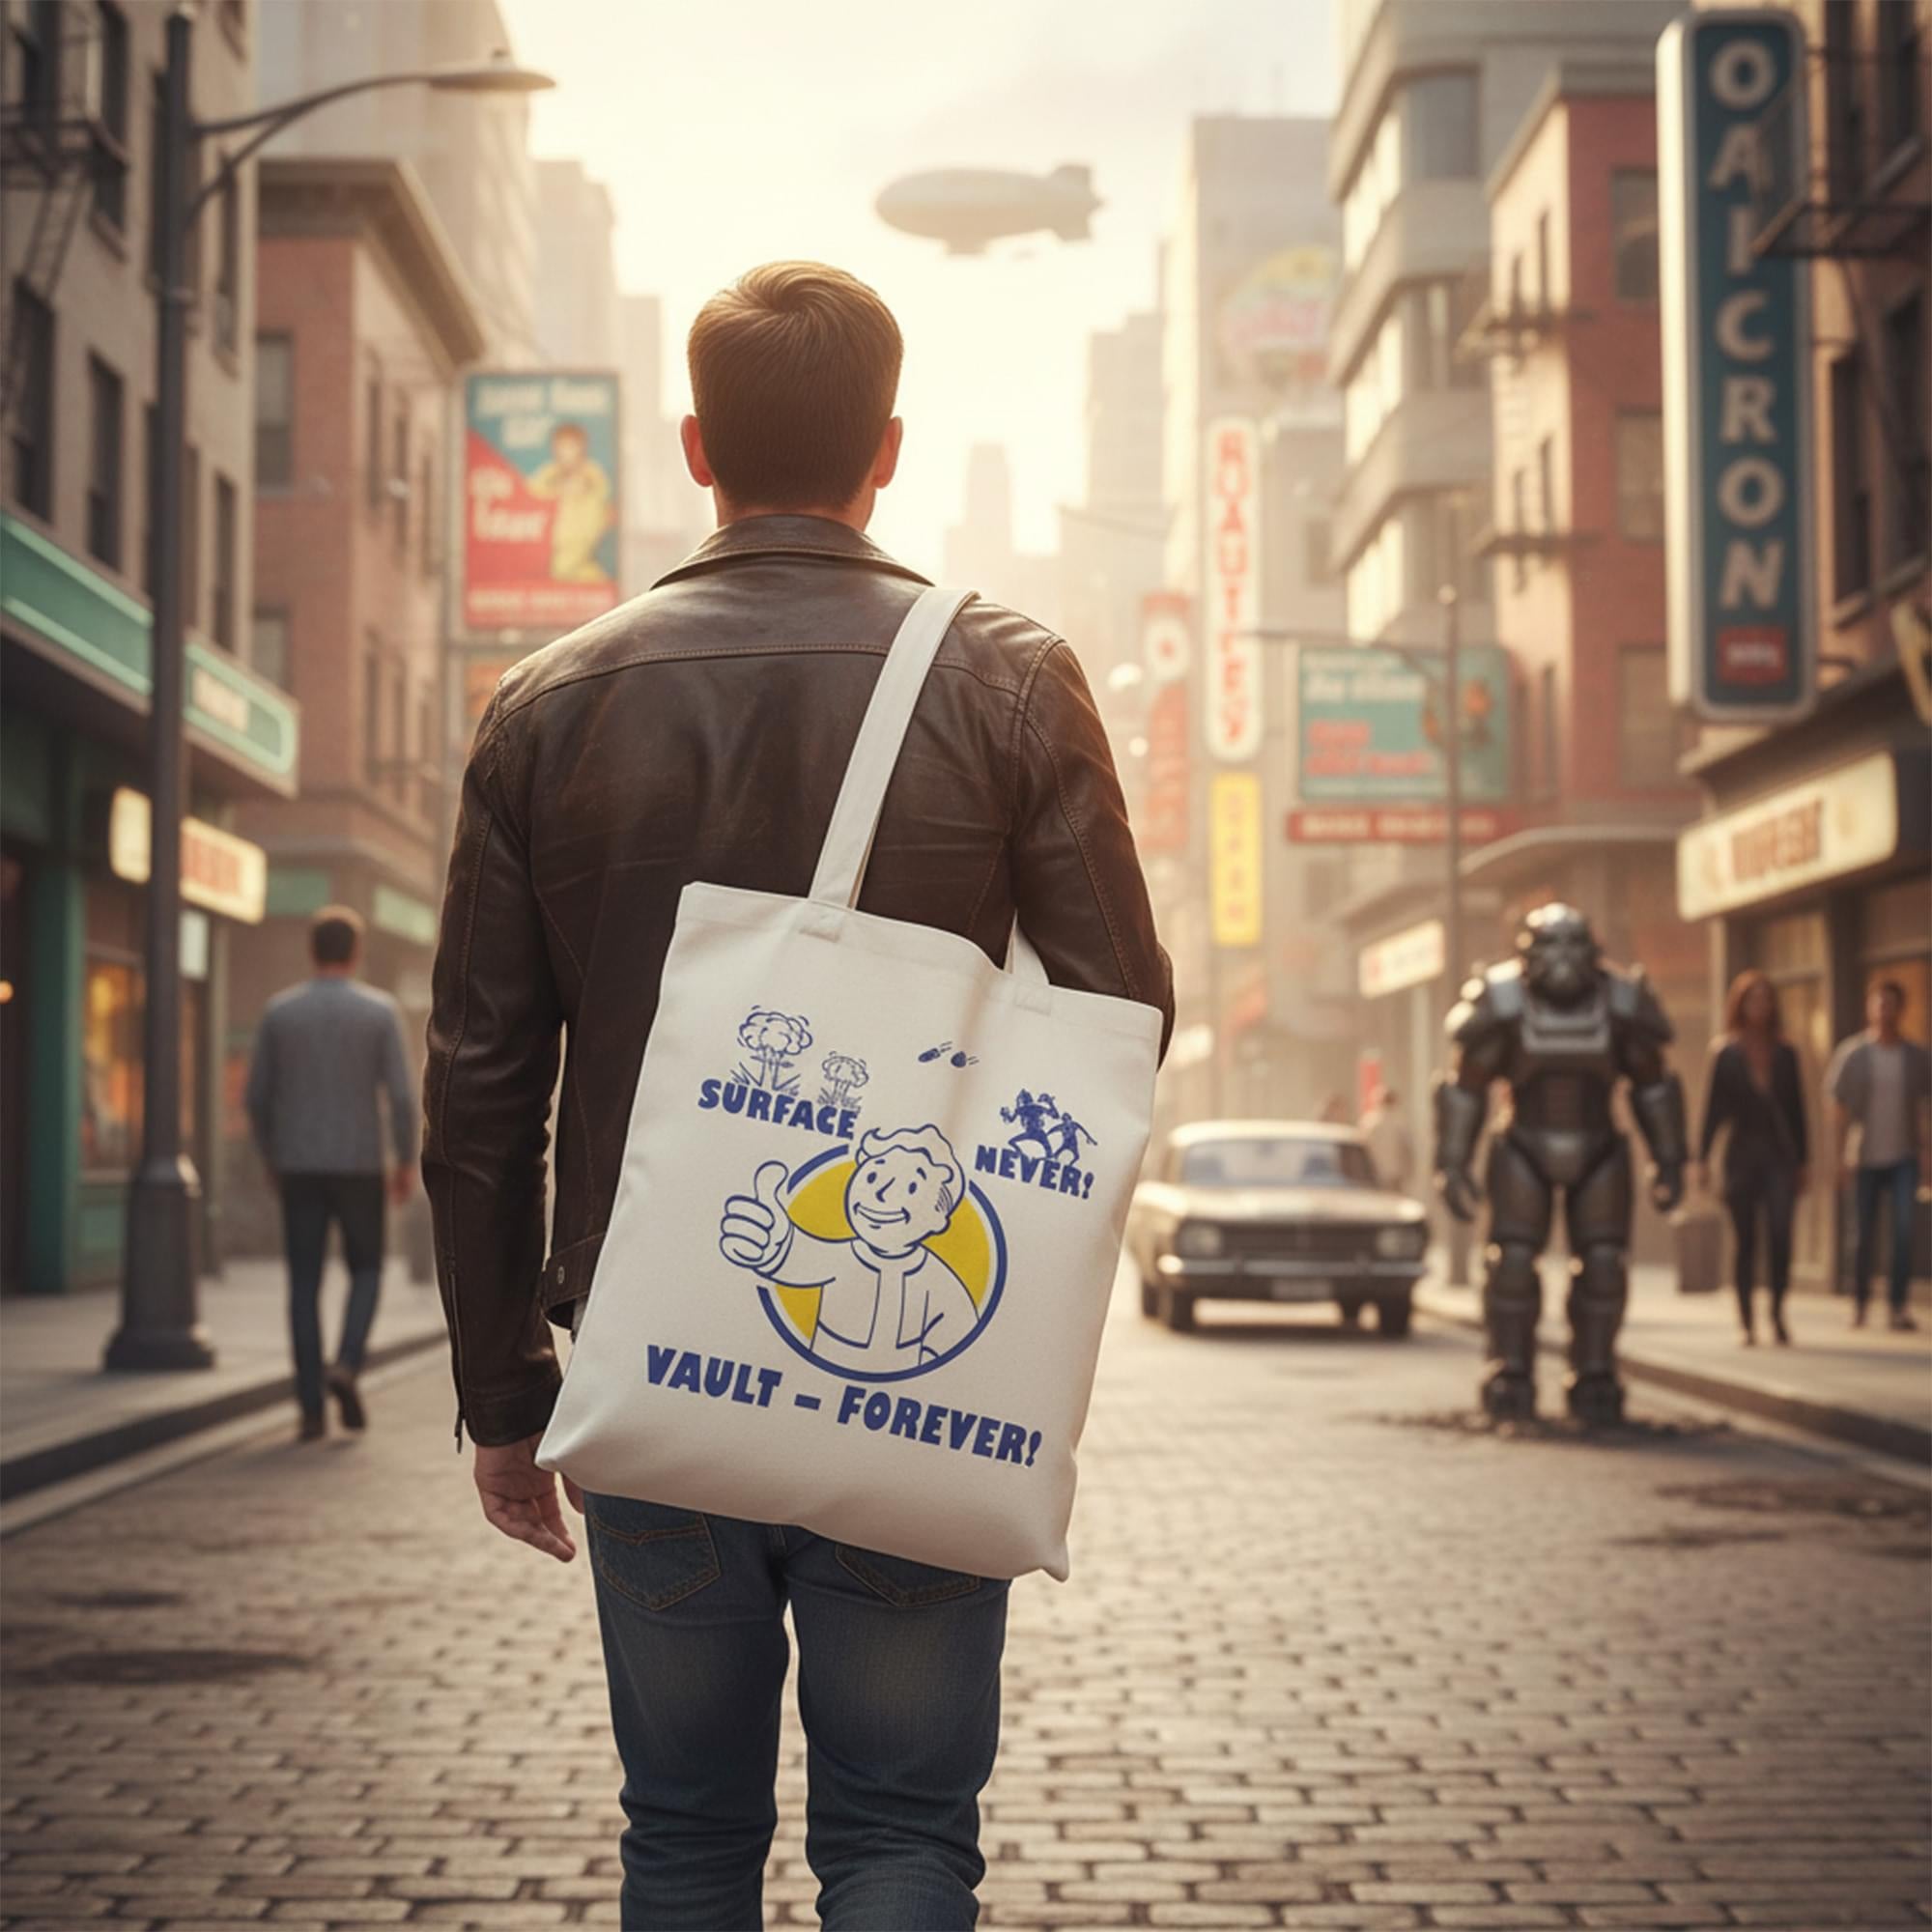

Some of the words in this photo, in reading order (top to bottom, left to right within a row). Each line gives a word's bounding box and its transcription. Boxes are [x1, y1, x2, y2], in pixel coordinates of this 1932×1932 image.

[696, 1077, 858, 1141] SURFACE
[975, 1145, 1094, 1200] NEVER!
[645, 1344, 782, 1408] VAULT
[837, 1385, 1043, 1467] FOREVER!
